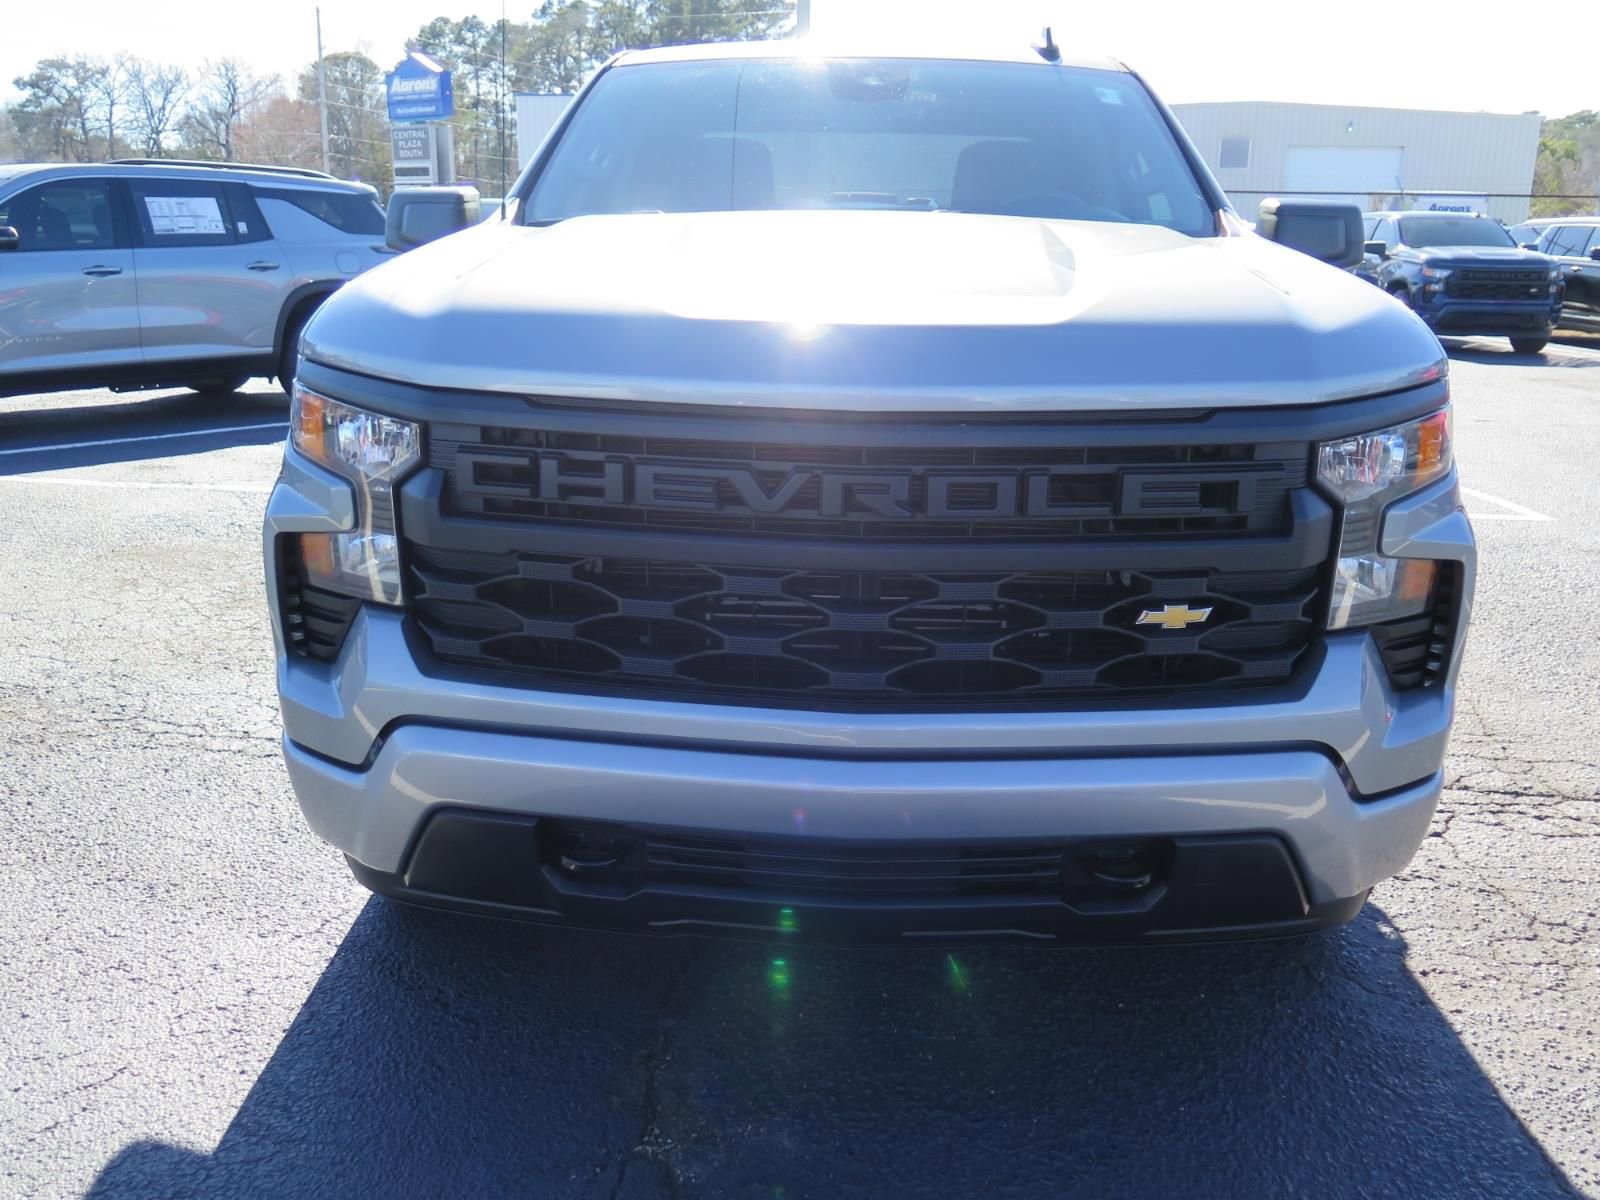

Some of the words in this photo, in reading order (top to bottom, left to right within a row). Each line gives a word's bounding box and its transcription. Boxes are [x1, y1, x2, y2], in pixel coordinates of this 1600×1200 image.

[394, 130, 427, 139] CENTRAL
[399, 140, 422, 148] PLAZA
[400, 149, 424, 158] SOUTH
[456, 445, 1285, 517] CHEVROLET
